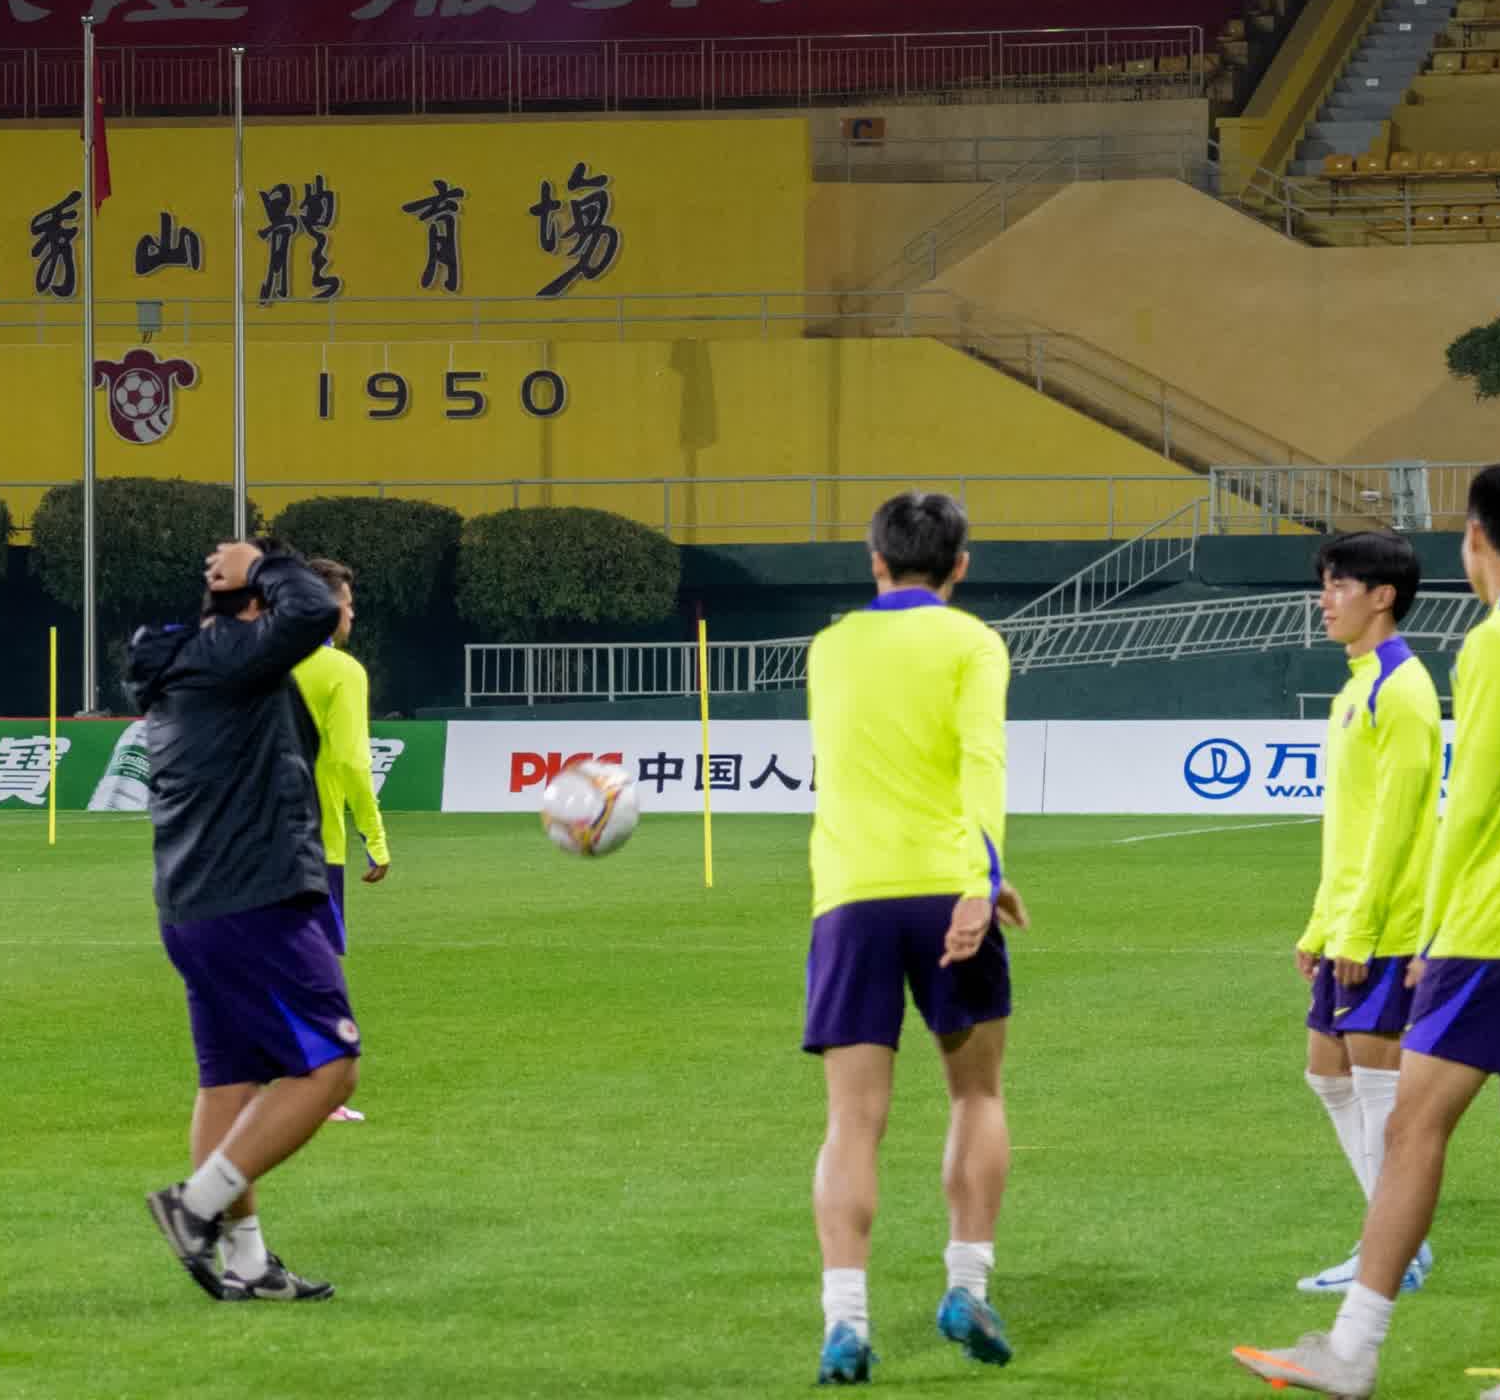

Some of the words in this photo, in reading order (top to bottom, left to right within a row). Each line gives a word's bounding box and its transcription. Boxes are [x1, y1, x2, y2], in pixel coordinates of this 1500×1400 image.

[316, 368, 568, 422] 1950
[638, 750, 815, 794] 中国人
